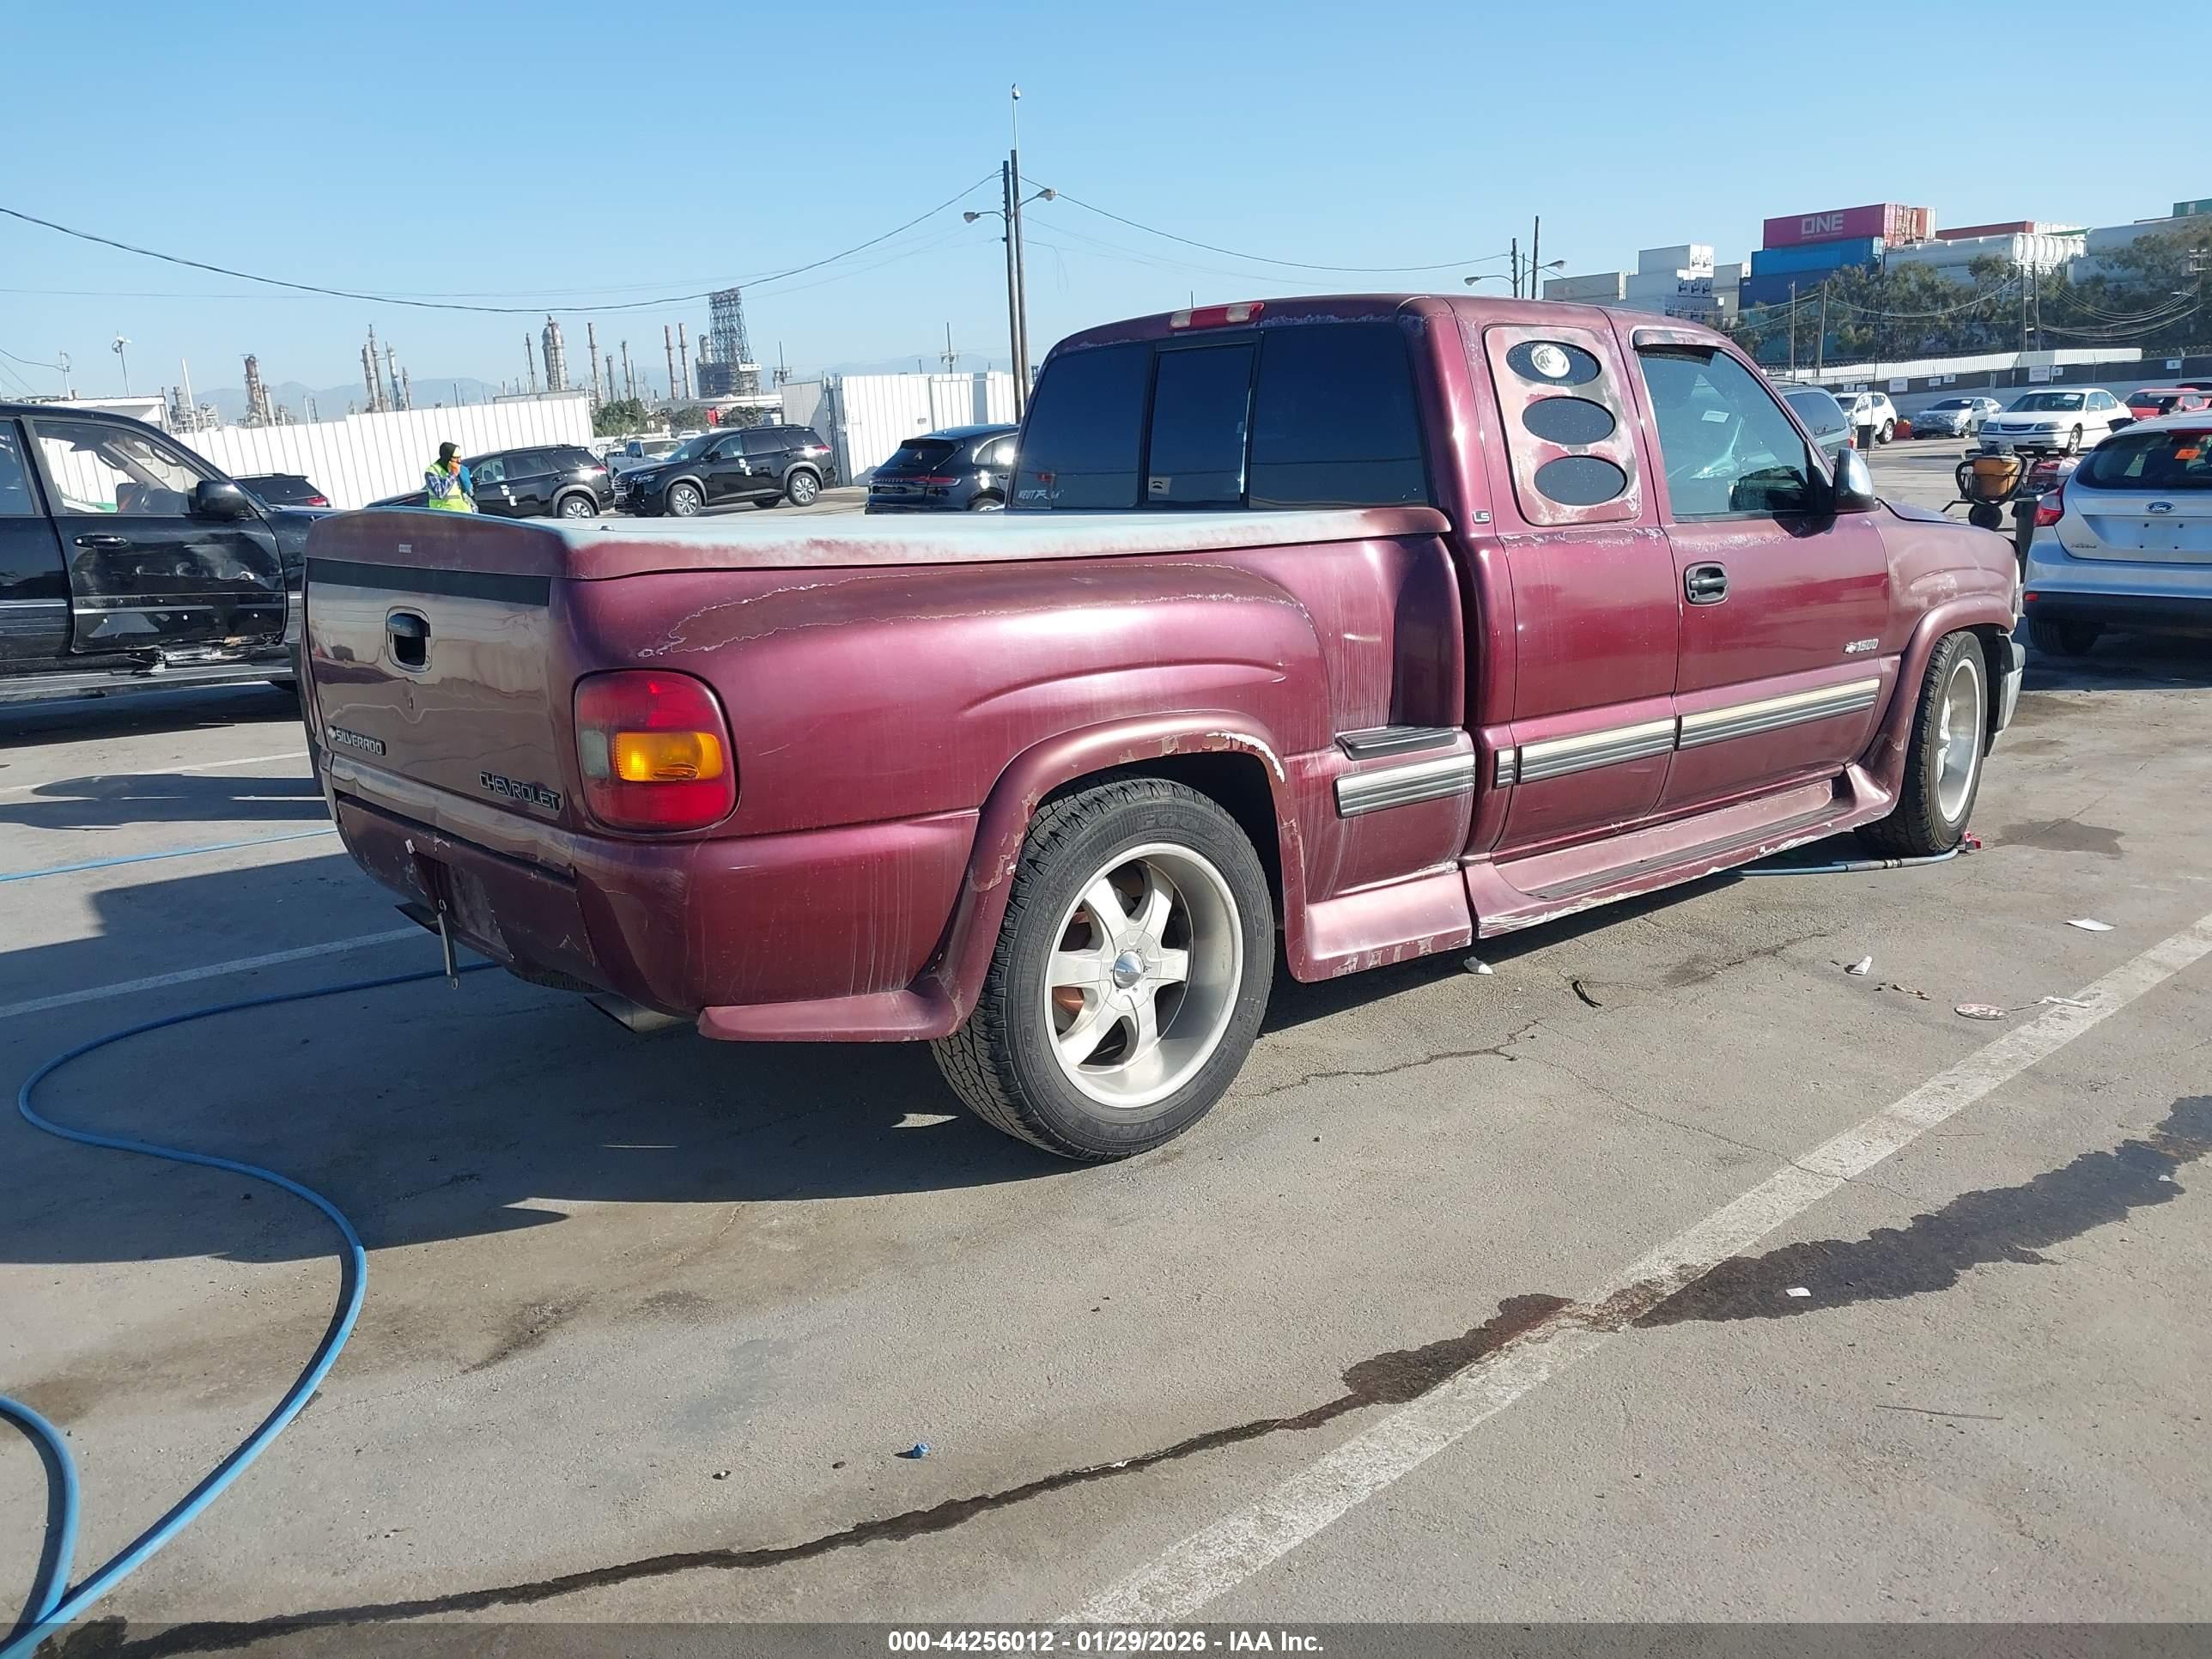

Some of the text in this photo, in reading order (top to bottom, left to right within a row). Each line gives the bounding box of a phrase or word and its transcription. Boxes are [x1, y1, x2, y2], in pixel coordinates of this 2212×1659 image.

[1802, 213, 1844, 234] ONE
[1472, 511, 1490, 522] LS
[336, 729, 384, 756] SILVERADO
[479, 772, 560, 810] CHEVROLET
